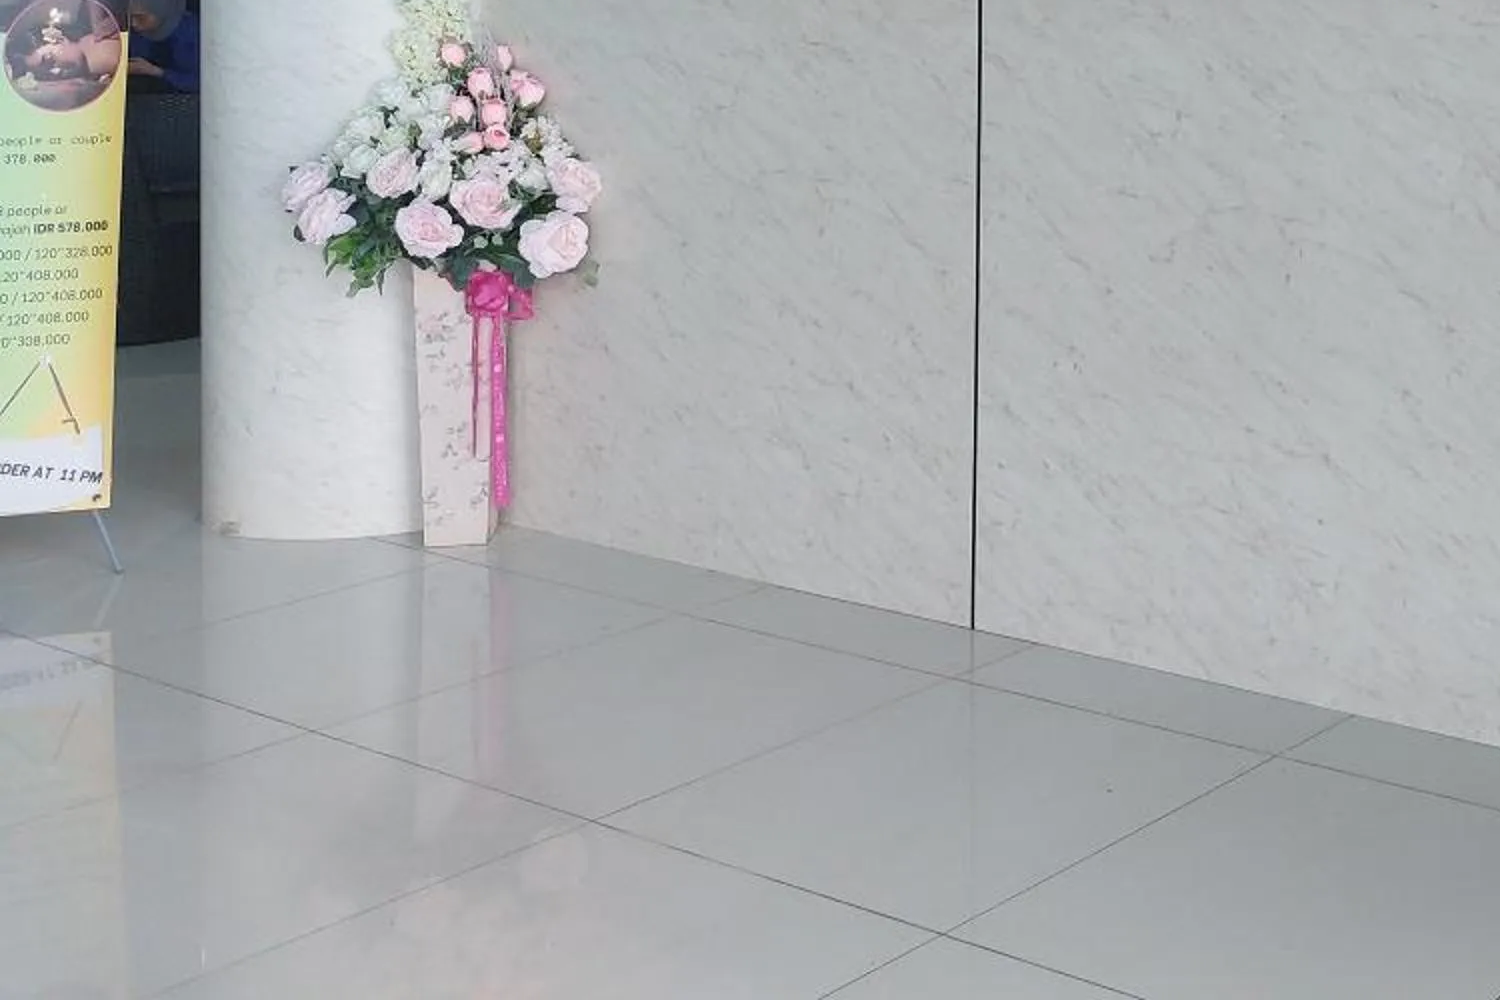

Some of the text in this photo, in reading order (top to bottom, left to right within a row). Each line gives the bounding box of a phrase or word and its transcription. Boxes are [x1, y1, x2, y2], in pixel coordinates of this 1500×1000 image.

[7, 204, 52, 219] people
[33, 223, 55, 234] IDR
[57, 220, 109, 233] 578.000
[32, 466, 55, 479] AT
[79, 470, 103, 484] PM
